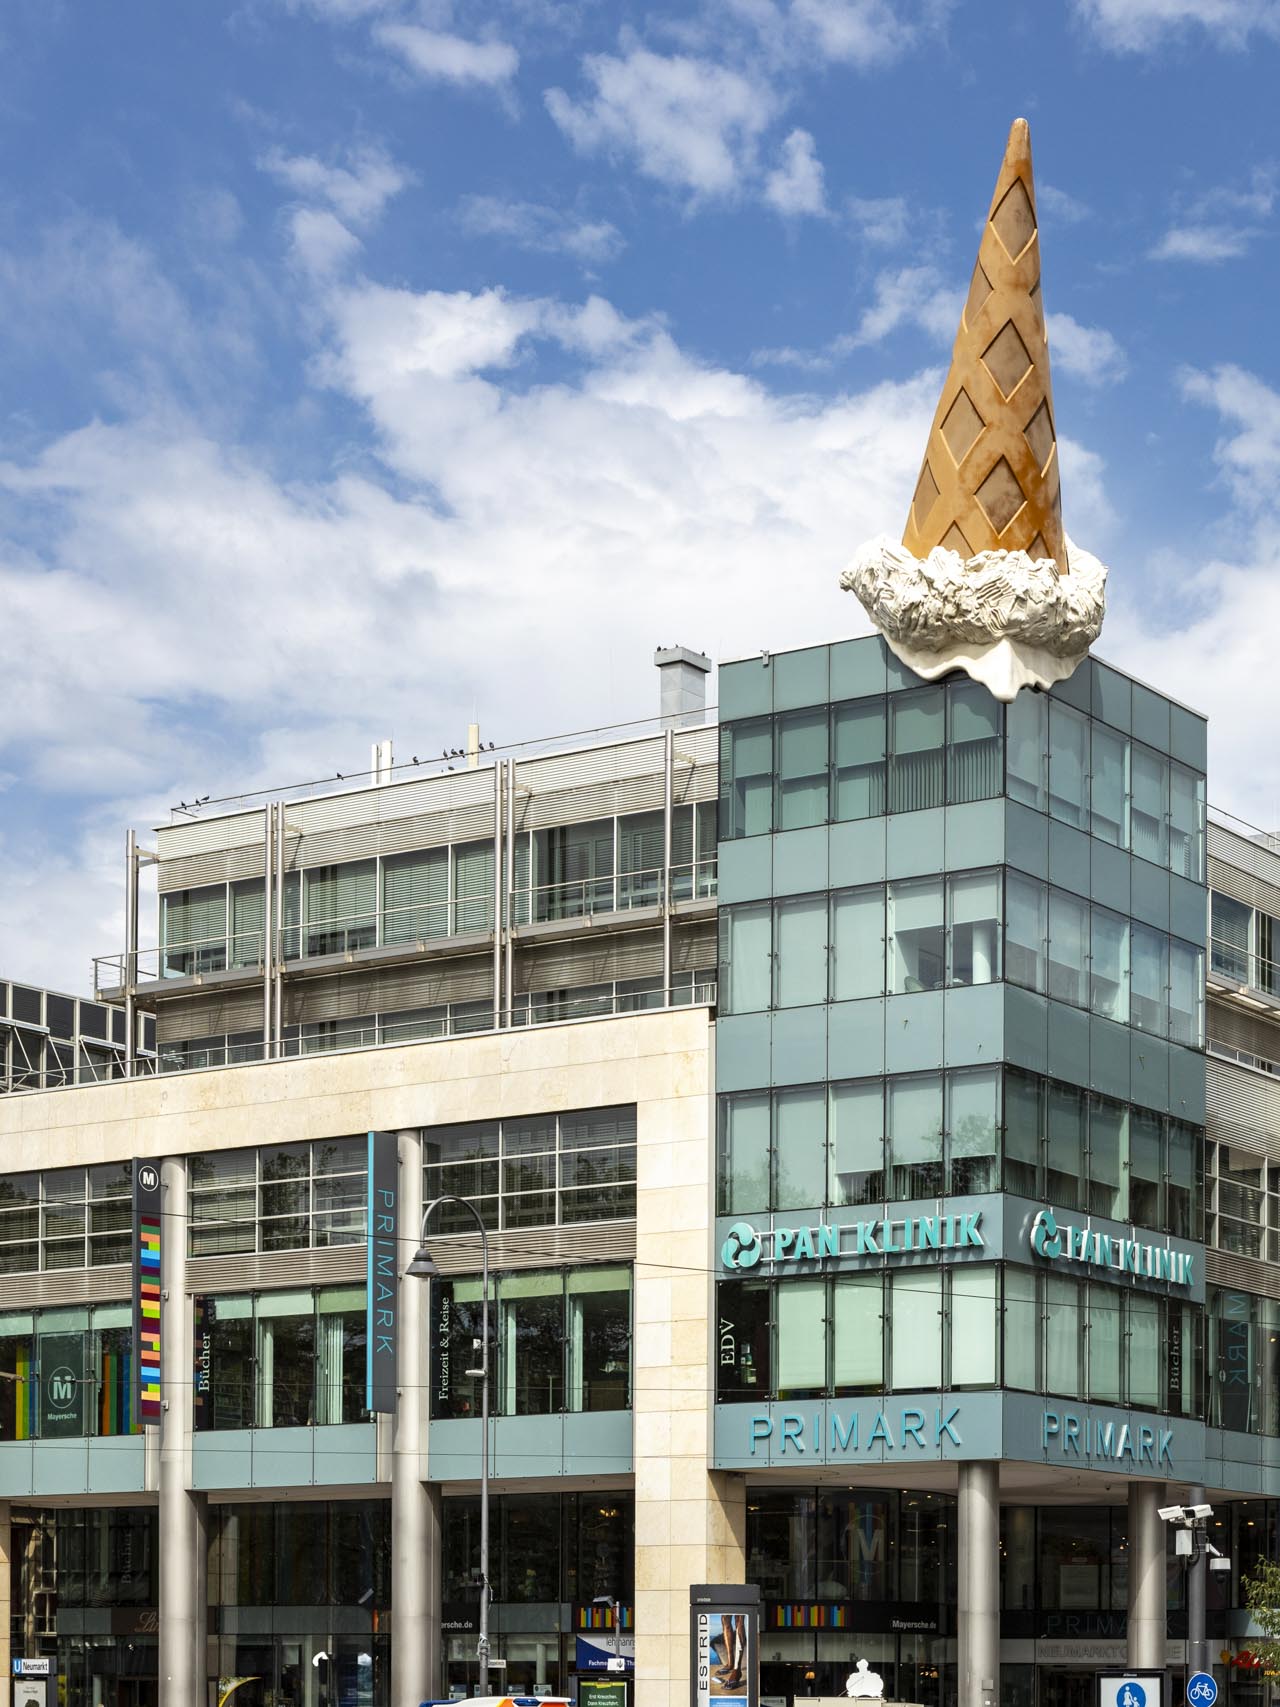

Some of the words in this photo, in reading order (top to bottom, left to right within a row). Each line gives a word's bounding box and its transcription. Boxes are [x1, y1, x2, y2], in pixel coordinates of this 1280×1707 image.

[143, 1171, 155, 1186] M
[774, 1224, 840, 1261] PAN
[857, 1211, 985, 1255] KLINIK
[1067, 1225, 1113, 1265] PAN
[1119, 1238, 1195, 1286] KLINIK
[377, 1189, 394, 1353] PRIMARK
[439, 1296, 450, 1332] Reise
[198, 1332, 211, 1392] Bücher
[439, 1339, 449, 1349] &
[720, 1317, 735, 1366] EDV
[1170, 1325, 1180, 1389] Bücher
[53, 1375, 72, 1400] M
[438, 1351, 449, 1401] Freizeit
[47, 1412, 77, 1422] Mayersche
[749, 1407, 961, 1454] PRIMARK
[1042, 1411, 1175, 1467] PRIMARK
[892, 1620, 937, 1630] Mayersche.de
[14, 1659, 21, 1673] U
[23, 1661, 48, 1671] Neumarkt
[699, 1614, 708, 1691] ESTRID
